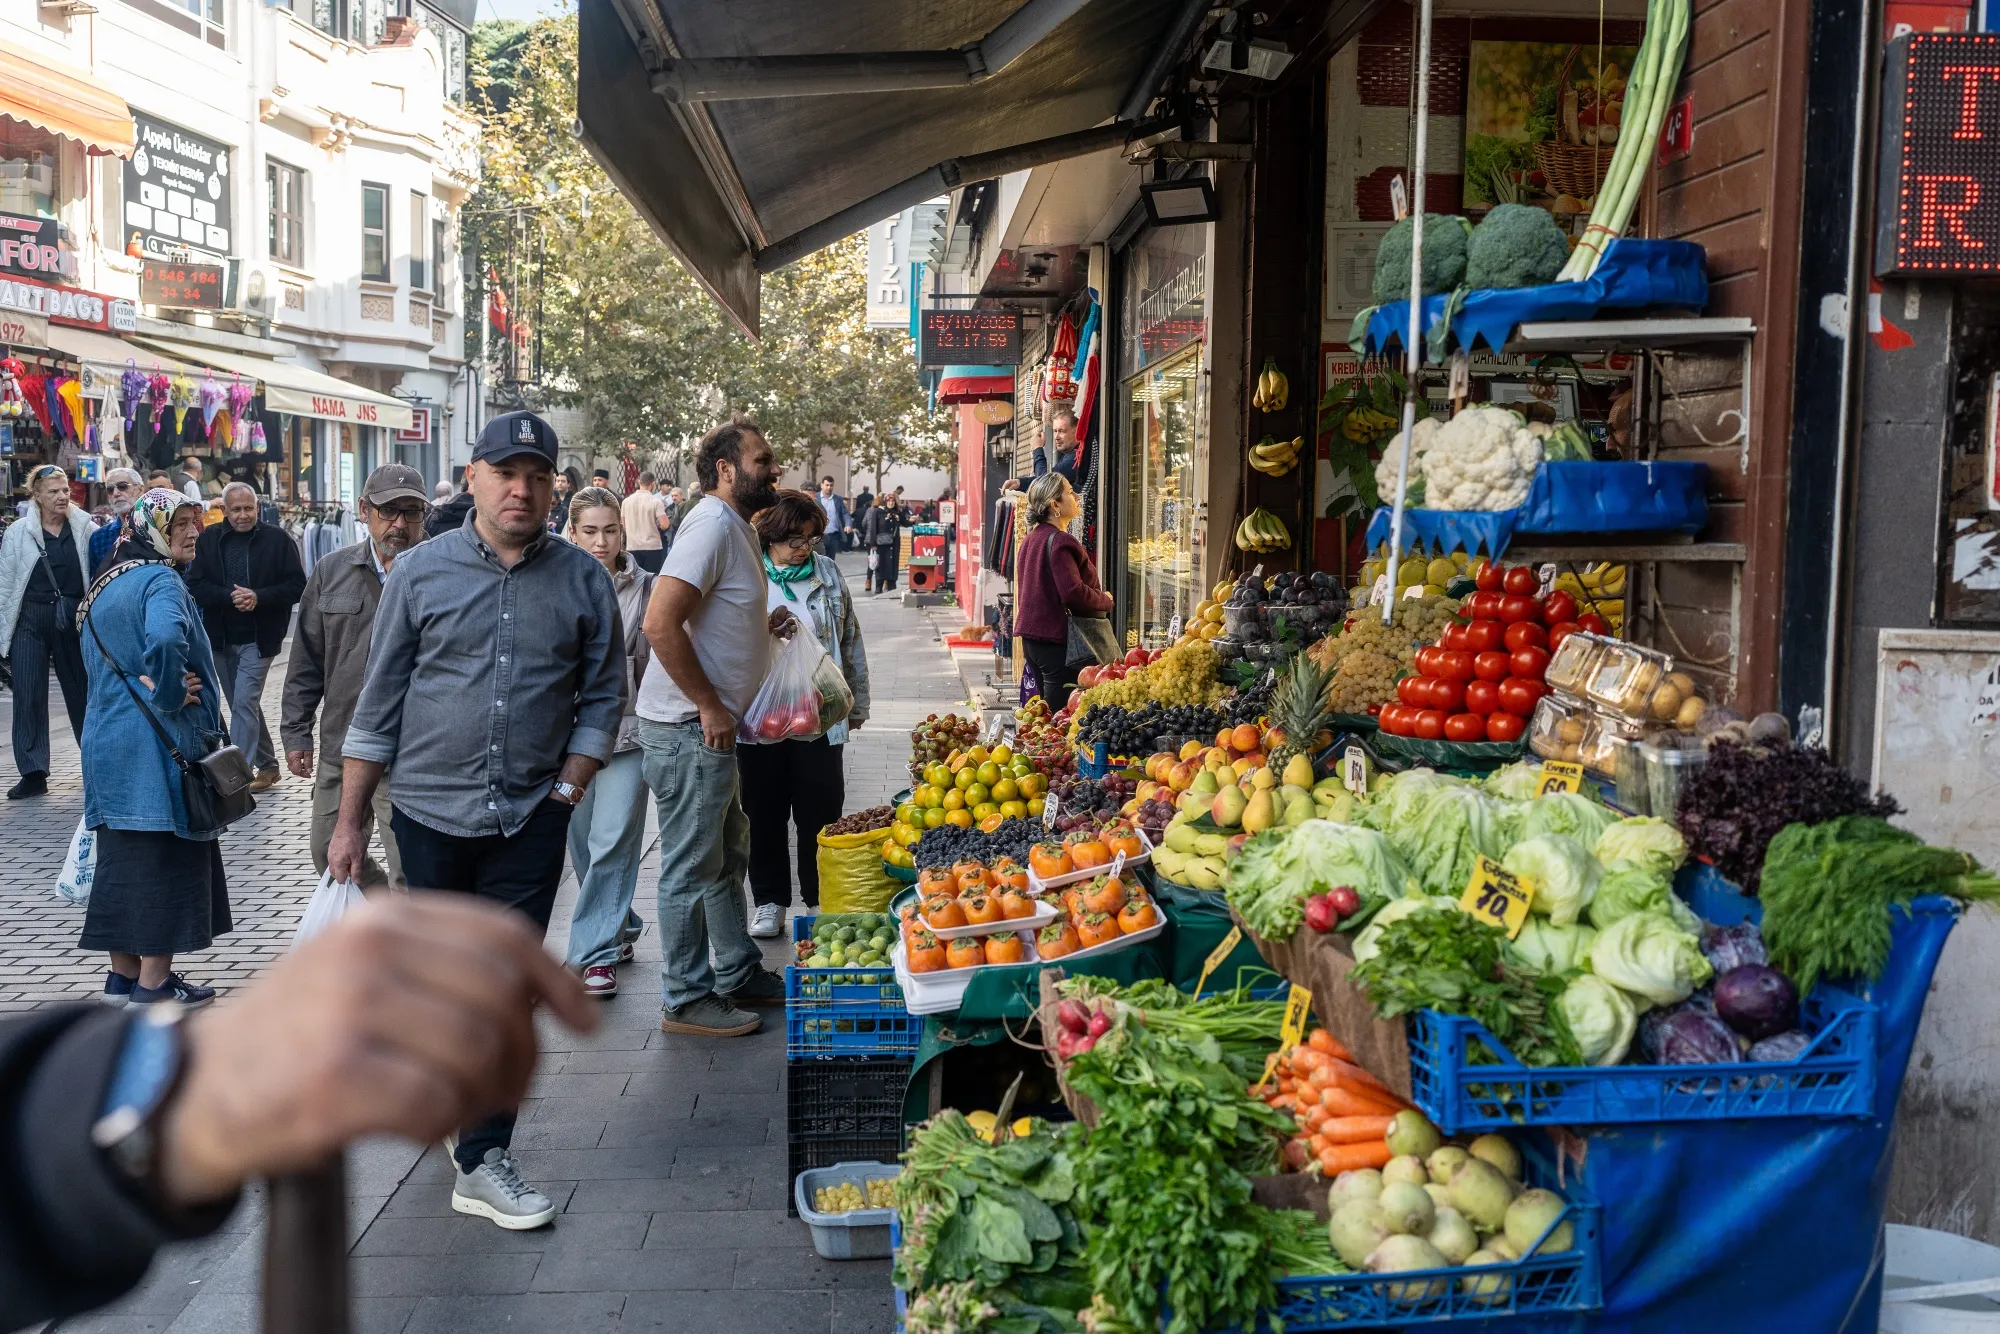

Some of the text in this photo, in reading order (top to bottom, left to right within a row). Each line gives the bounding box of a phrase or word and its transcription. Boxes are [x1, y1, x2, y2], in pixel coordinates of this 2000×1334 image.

[143, 125, 171, 150] Apple
[0, 235, 59, 273] FÖR
[878, 212, 903, 303] rizm
[1175, 253, 1206, 311] İBRAH
[48, 289, 104, 323] BAGS
[928, 315, 1016, 330] 15/10/2025
[0, 322, 25, 342] 972
[312, 397, 377, 422] NAMA JNS
[1476, 881, 1508, 917] 70
